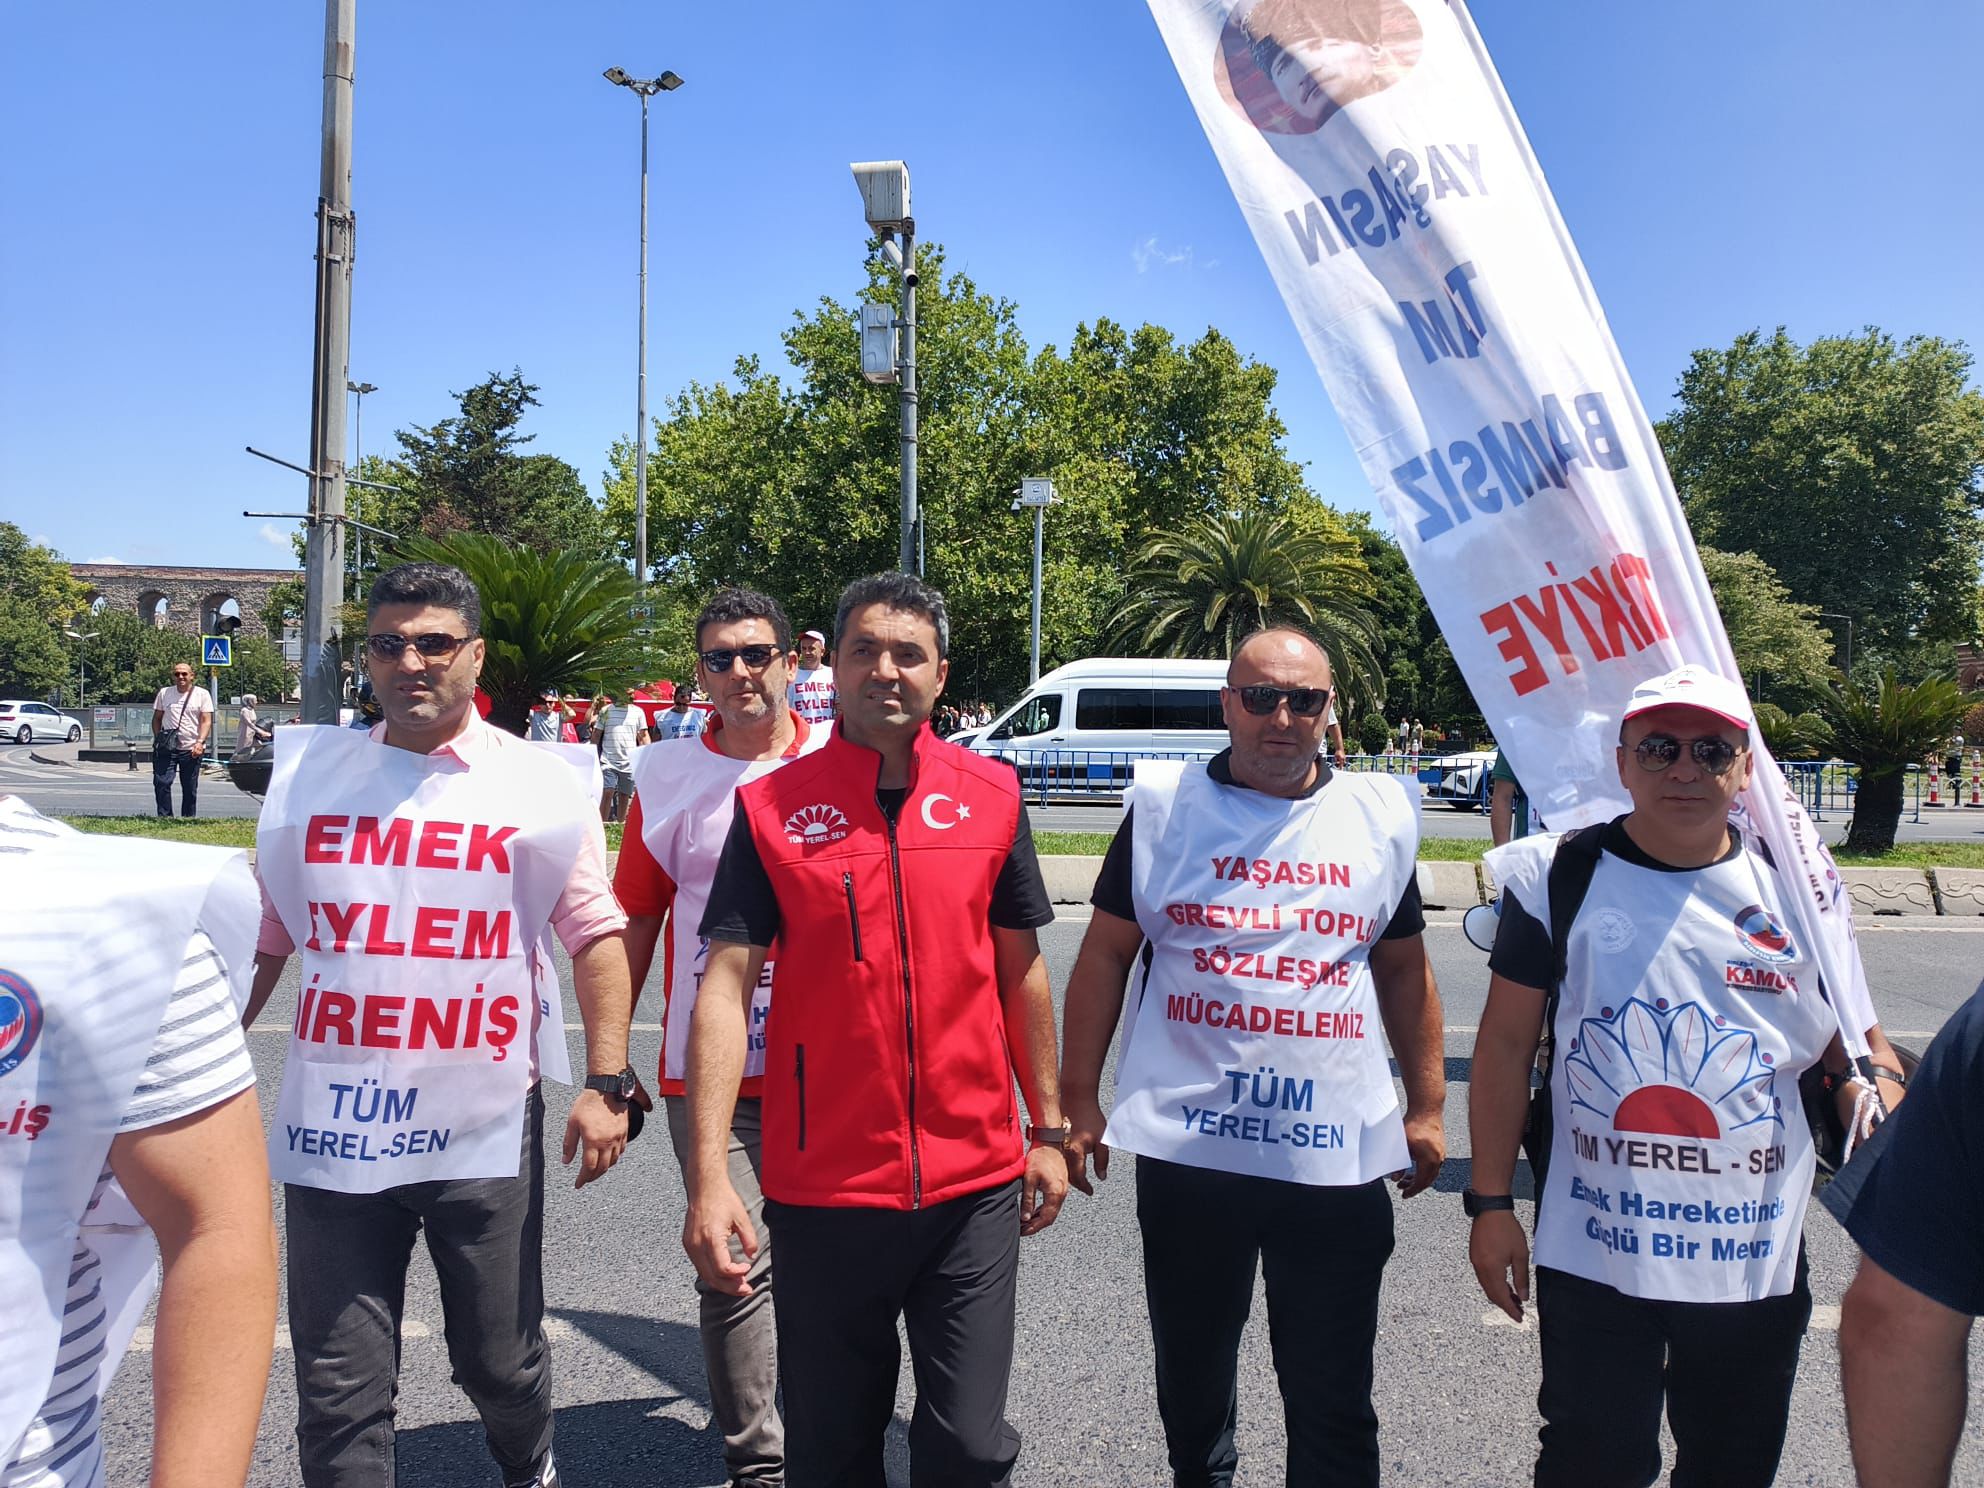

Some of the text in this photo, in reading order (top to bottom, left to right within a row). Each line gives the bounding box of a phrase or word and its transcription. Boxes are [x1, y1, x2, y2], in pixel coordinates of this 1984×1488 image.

[305, 815, 520, 873] EMEK
[805, 831, 846, 844] YEREL-SEN
[1211, 856, 1351, 889] YAŞASIN
[1166, 904, 1378, 943] GREVLİ TOPLU
[294, 973, 520, 1062] İRENİŞ
[1167, 992, 1365, 1039] MÜCADELEMİZ
[329, 1078, 418, 1124] TÜM
[1225, 1066, 1314, 1112] TÜM
[286, 1124, 451, 1162] YEREL-SEN
[1181, 1105, 1345, 1149] YEREL-SEN
[1605, 1137, 1722, 1175] YEREL
[1748, 1144, 1785, 1175] SEN
[1619, 1190, 1785, 1225] Hareketinde
[1652, 1232, 1701, 1261] Bir
[1711, 1233, 1776, 1262] Mevzi
